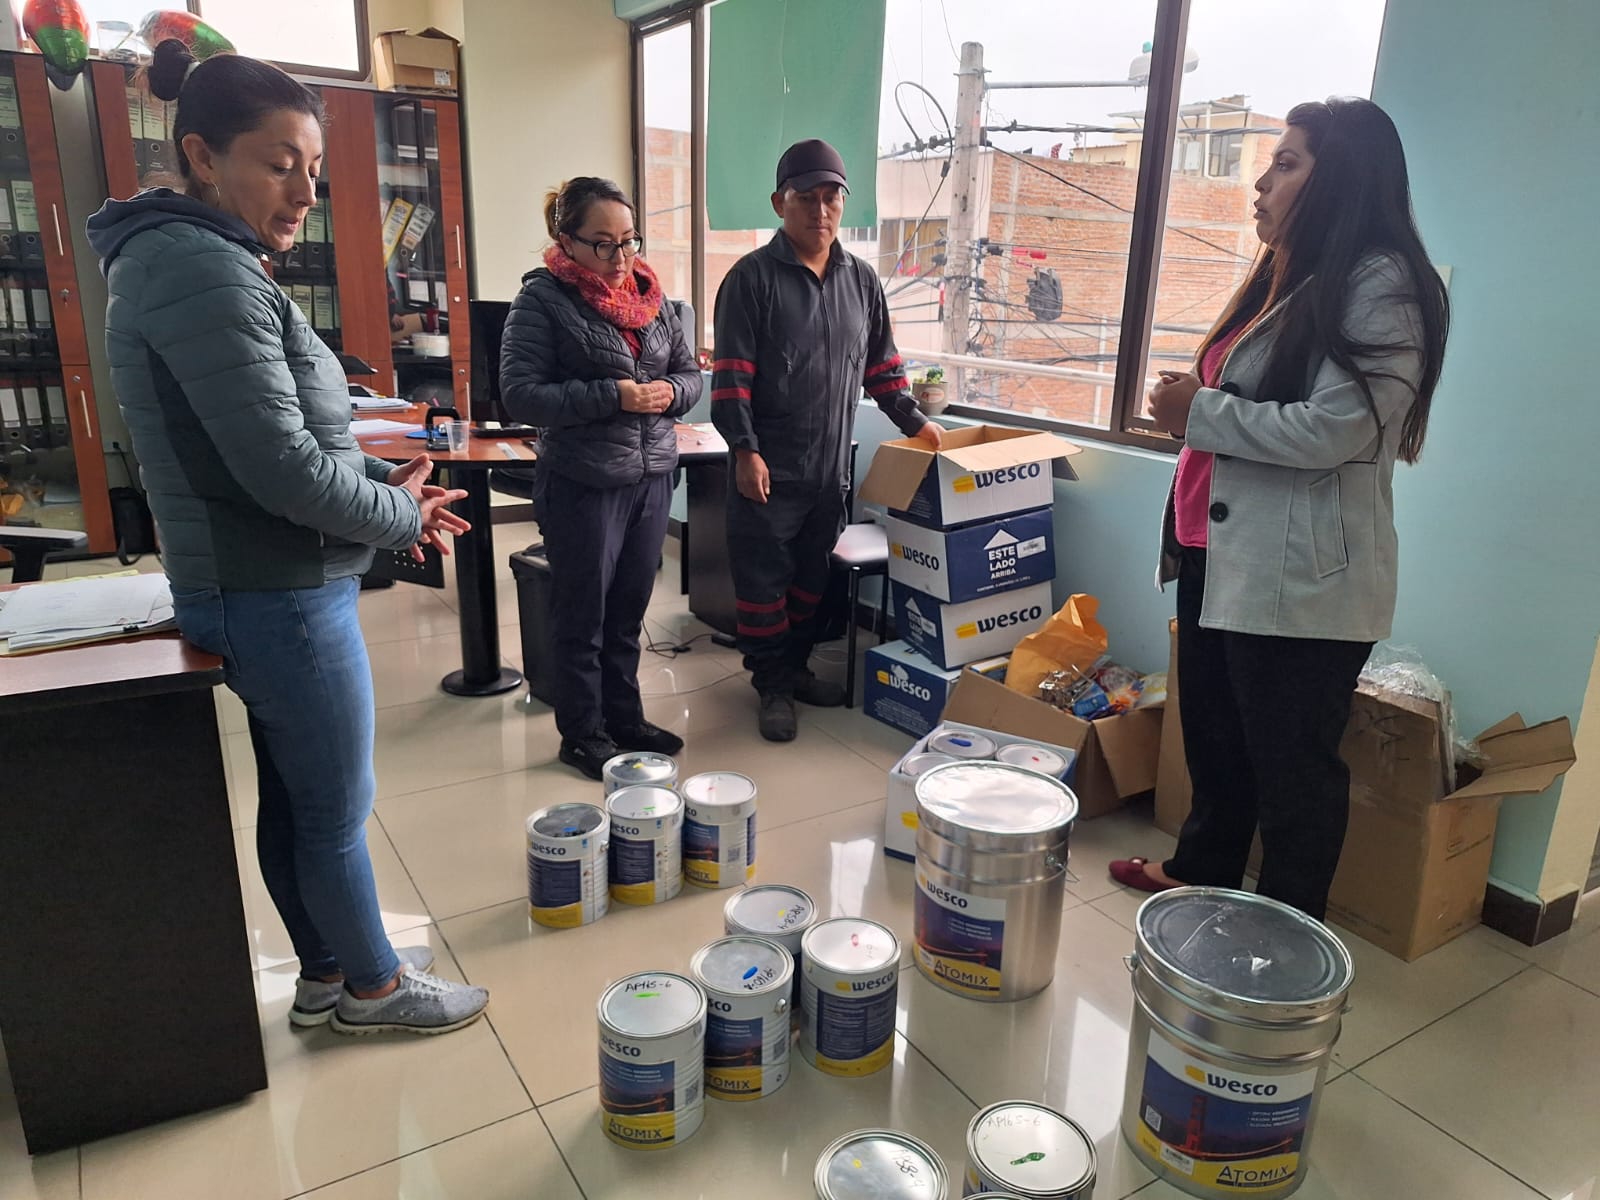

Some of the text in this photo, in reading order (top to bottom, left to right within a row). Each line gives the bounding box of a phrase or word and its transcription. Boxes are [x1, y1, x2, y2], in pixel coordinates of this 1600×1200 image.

[975, 462, 1040, 489] wesco
[902, 545, 940, 571] wesco
[988, 545, 1016, 560] ESTE
[989, 558, 1016, 572] LADO
[990, 568, 1016, 580] ARRIBA
[977, 605, 1042, 633] wesco
[889, 674, 931, 701] wesco
[926, 882, 968, 909] wesco
[851, 971, 895, 992] wesco
[934, 959, 989, 986] ATOMIX
[1207, 1071, 1278, 1097] wesco
[608, 1118, 662, 1139] ATOMIX
[1218, 1165, 1289, 1184] ATOMIX
